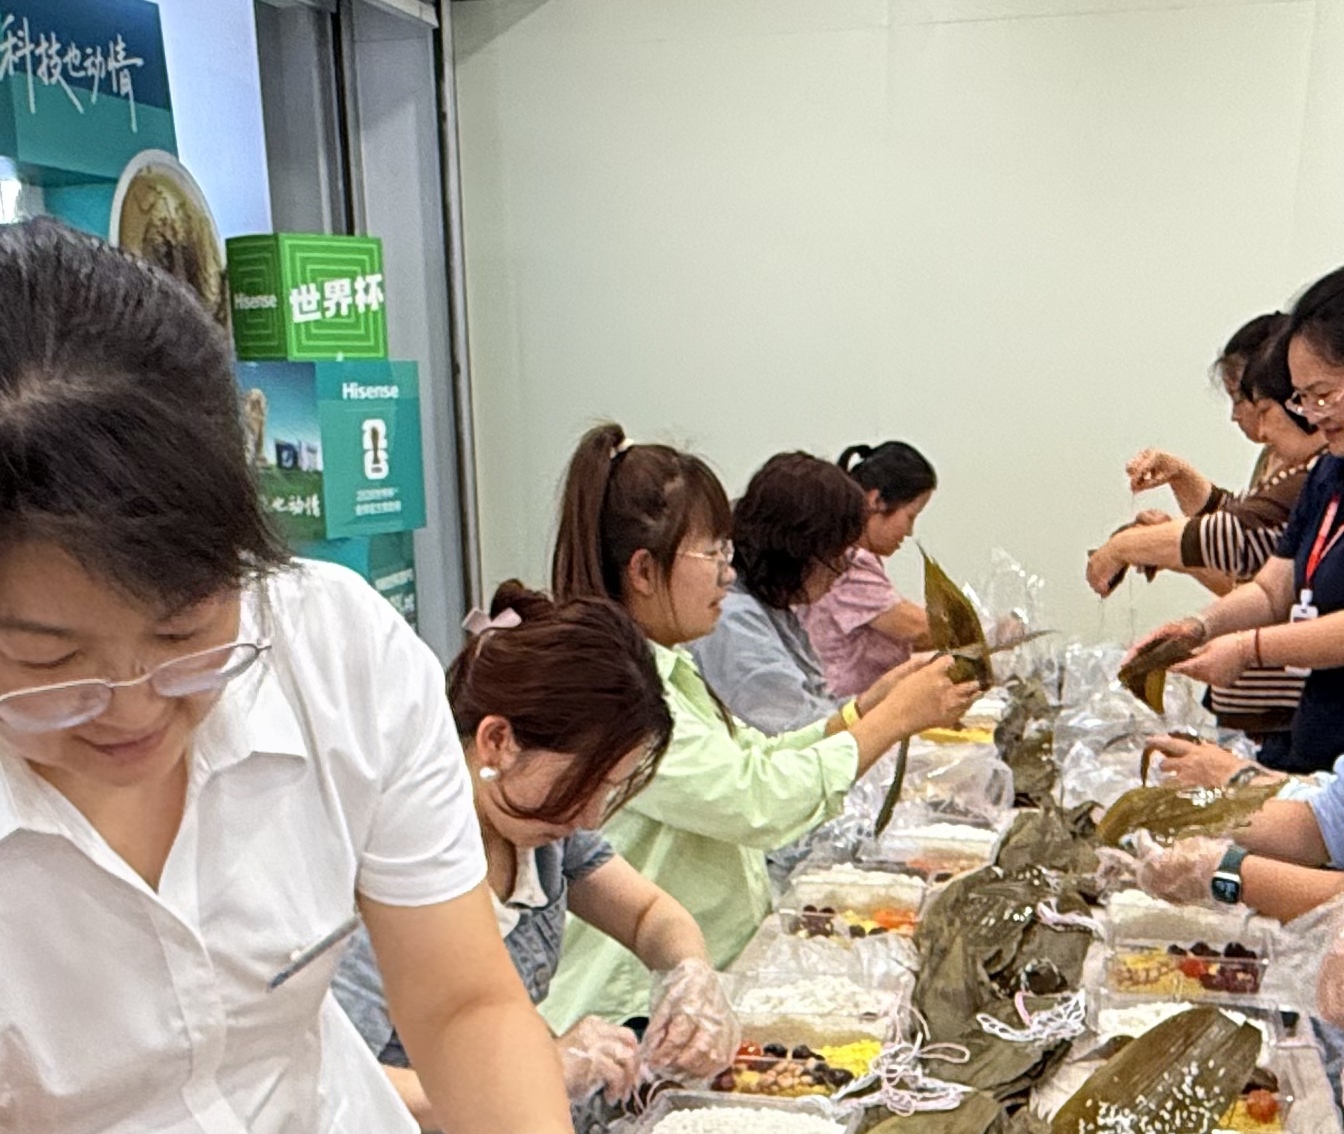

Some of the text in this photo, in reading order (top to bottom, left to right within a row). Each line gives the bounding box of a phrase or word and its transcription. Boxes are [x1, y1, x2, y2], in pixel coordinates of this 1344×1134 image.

[289, 273, 384, 323] 世界杯
[342, 382, 400, 400] Hisense
